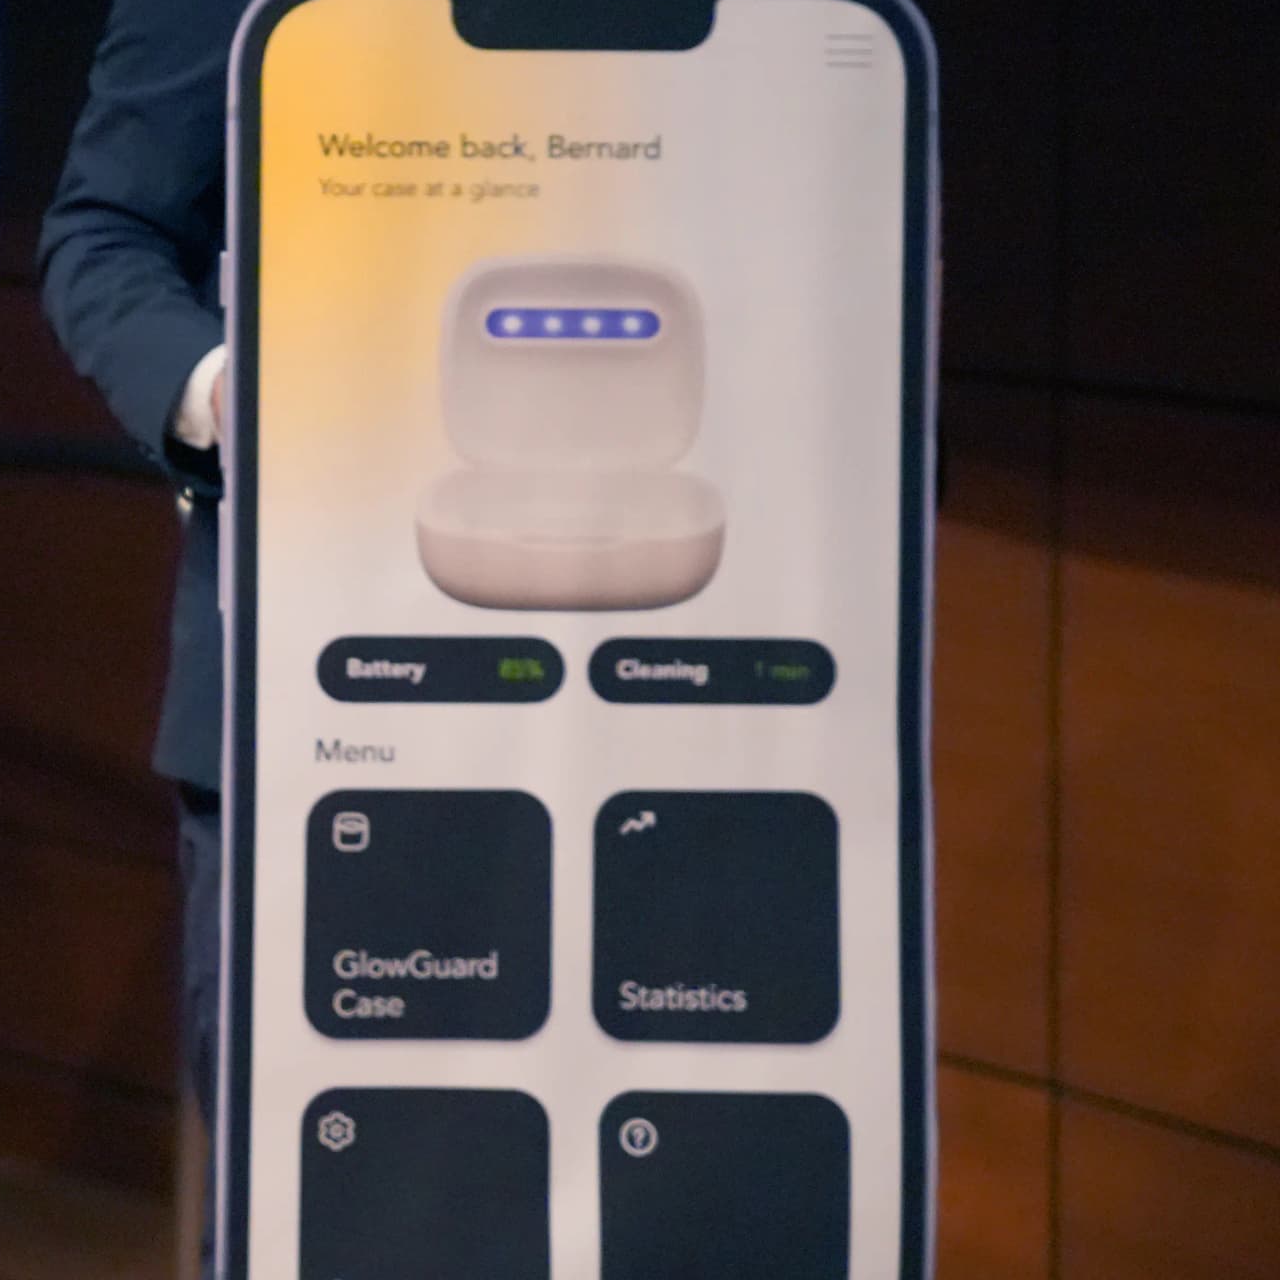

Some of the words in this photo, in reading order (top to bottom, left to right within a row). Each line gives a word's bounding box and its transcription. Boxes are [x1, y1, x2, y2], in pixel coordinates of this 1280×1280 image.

[318, 133, 450, 160] Welcome
[460, 133, 537, 162] back,
[547, 134, 663, 160] Bernard
[318, 177, 364, 197] Your
[371, 182, 418, 197] case
[424, 180, 444, 197] at
[470, 177, 540, 202] glance
[345, 657, 427, 686] Battery
[615, 658, 710, 687] Cleaning
[315, 739, 395, 765] Menu
[333, 950, 498, 980] GlowGuard
[333, 989, 405, 1019] Case
[619, 981, 748, 1012] Statistics
